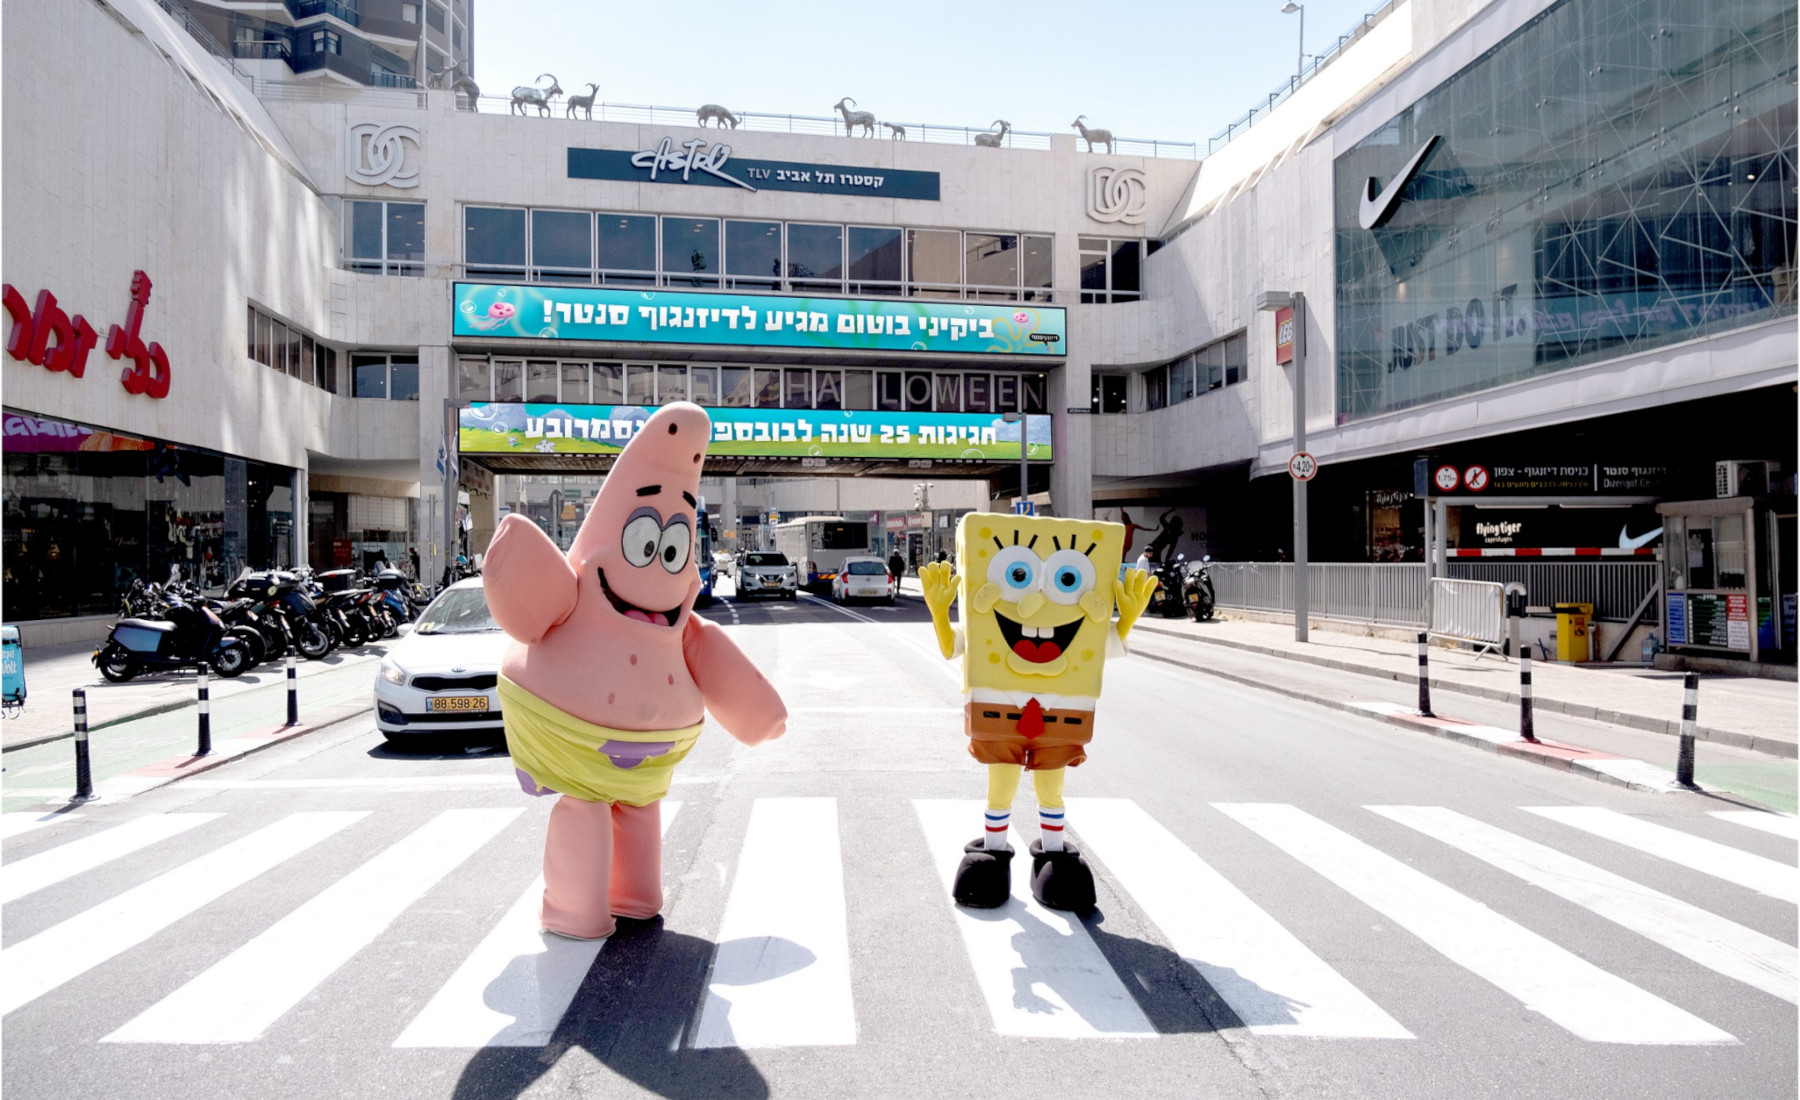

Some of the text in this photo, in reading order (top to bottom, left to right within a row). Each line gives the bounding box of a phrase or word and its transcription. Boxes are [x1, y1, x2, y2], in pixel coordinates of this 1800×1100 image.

[747, 167, 770, 180] TLV
[776, 169, 885, 188] קסטרו תל אביב
[543, 299, 994, 341] ביקיני בוטום מגיע לדיזנגוף סנטר!
[105, 270, 171, 399] כלי
[1278, 320, 1293, 346] LEG
[1388, 313, 1438, 374] JUST
[1446, 298, 1485, 356] DO
[709, 418, 812, 442] לבובספ
[821, 423, 871, 443] שנה
[880, 425, 909, 444] 25
[918, 425, 997, 445] חגיגות
[1493, 466, 1515, 477] צפון
[1524, 466, 1557, 477] דיזנגוף
[1560, 466, 1589, 476] כניסת
[1603, 466, 1628, 476] סנטר
[1476, 521, 1522, 537] flying tiger
